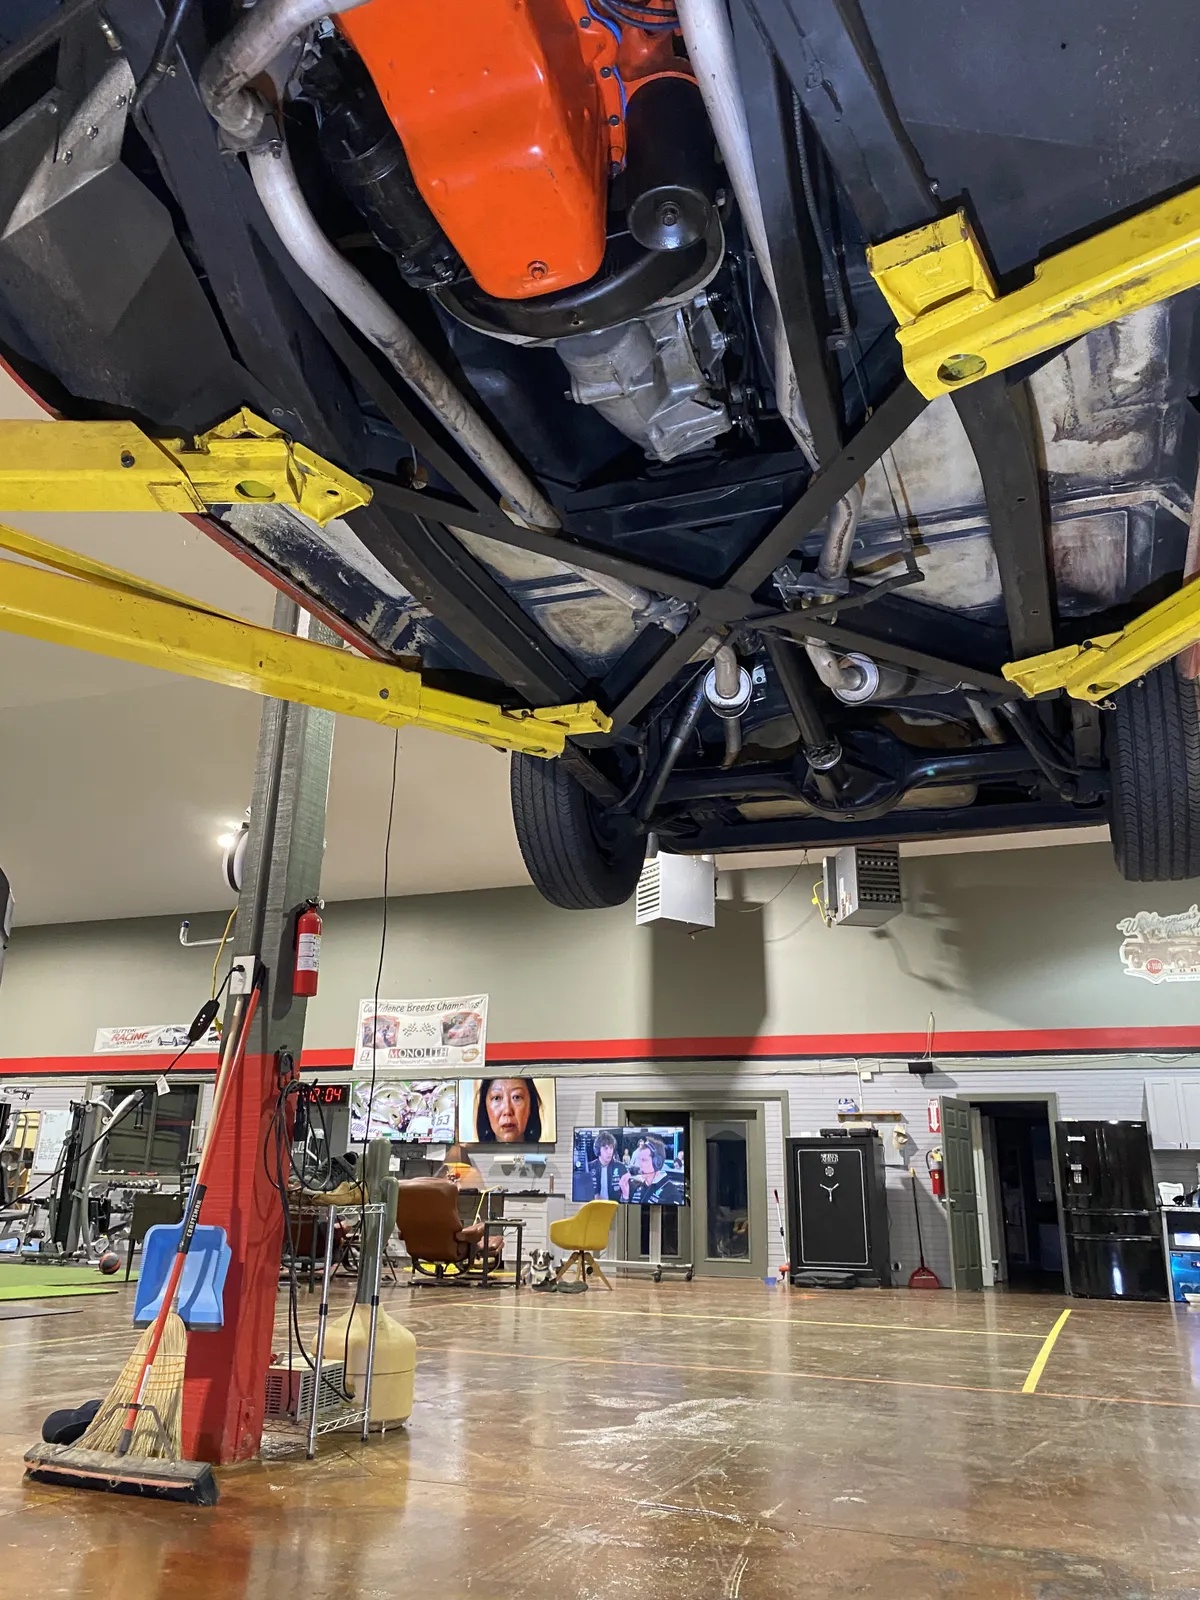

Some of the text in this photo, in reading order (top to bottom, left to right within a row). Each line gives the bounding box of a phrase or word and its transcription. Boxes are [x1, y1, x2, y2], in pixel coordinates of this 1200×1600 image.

[406, 1002, 435, 1013] Breeds
[111, 1031, 150, 1041] RACING
[388, 1047, 449, 1059] MONOLITH
[309, 1087, 342, 1102] 12:04
[186, 1199, 202, 1237] CRAFTSMAN
